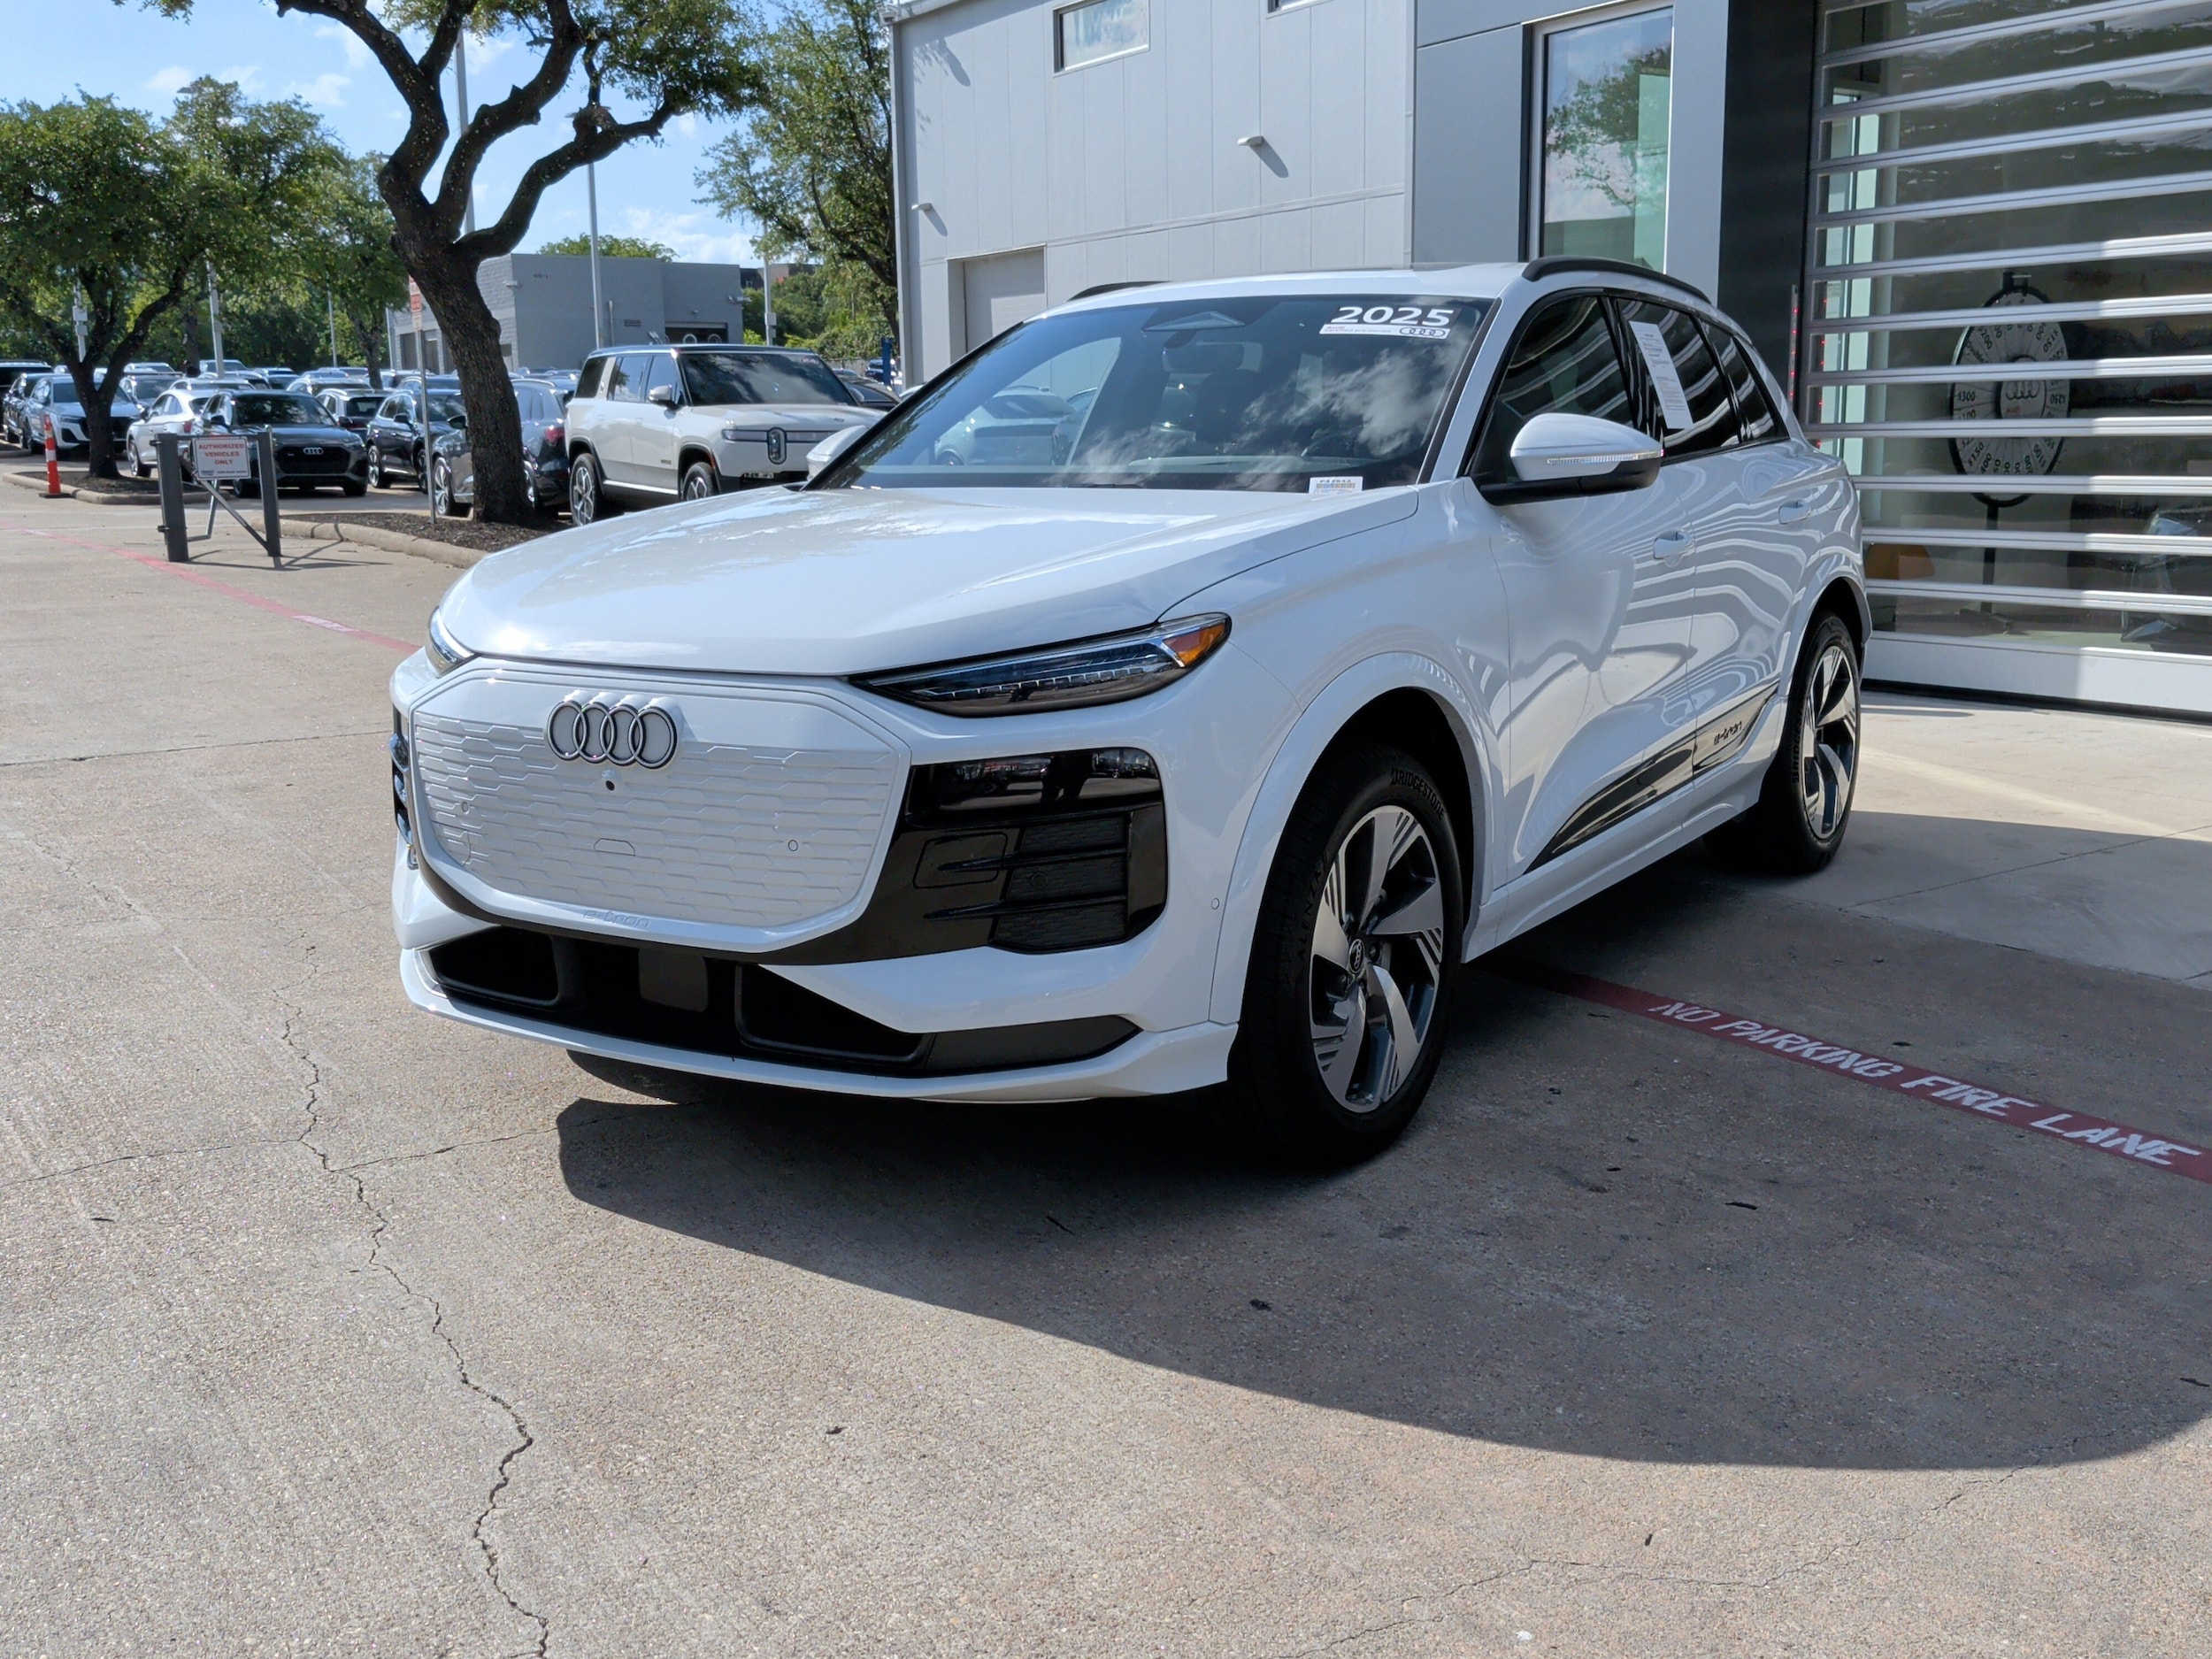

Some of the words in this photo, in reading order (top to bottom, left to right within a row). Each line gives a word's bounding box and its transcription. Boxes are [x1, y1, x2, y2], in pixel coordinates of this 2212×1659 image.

[1331, 306, 1454, 326] 2025
[1391, 768, 1444, 820] BRIDGESTONE
[583, 910, 650, 928] e-tron
[1648, 1002, 1721, 1022] NO
[1711, 1020, 1904, 1078] PARKING
[1900, 1076, 2039, 1117] FIRE
[2030, 1113, 2202, 1165] LANE
